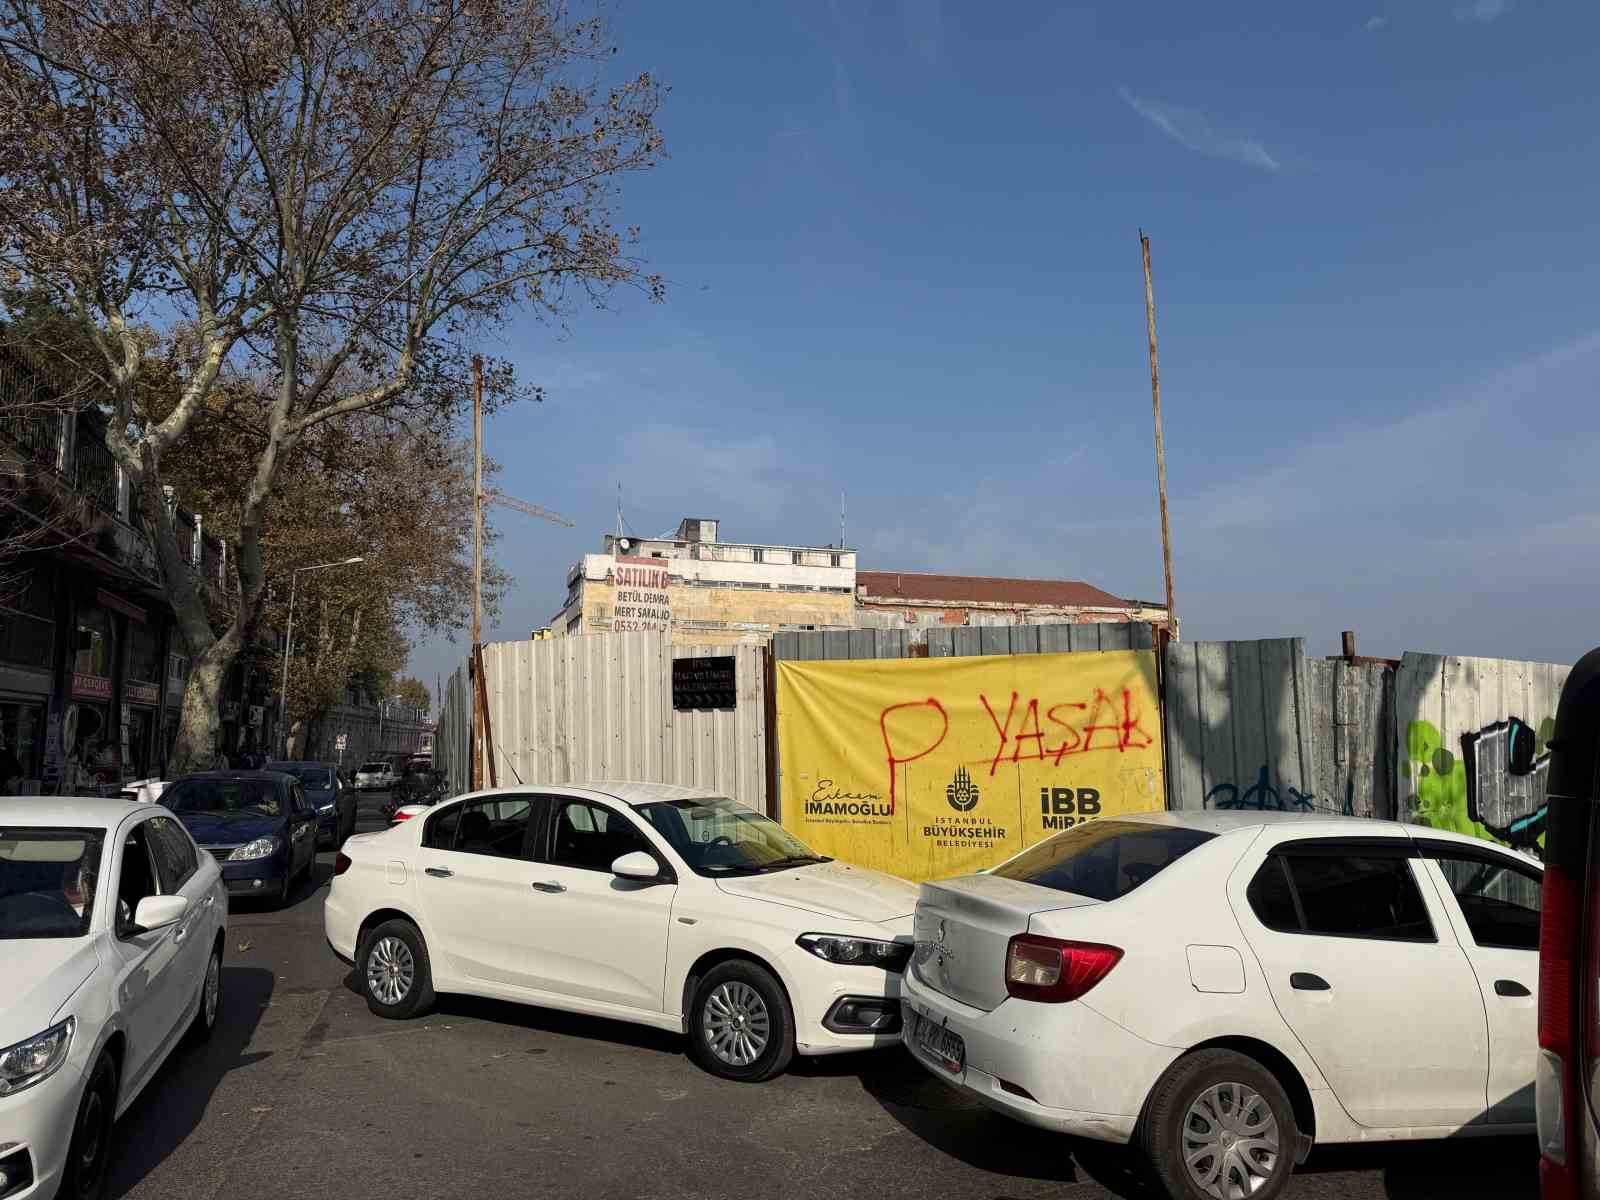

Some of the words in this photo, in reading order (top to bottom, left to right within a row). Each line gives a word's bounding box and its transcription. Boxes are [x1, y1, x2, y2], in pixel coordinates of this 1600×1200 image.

[616, 567, 659, 588] SATILIK
[617, 590, 642, 603] BETÜL
[614, 606, 636, 618] MERT
[880, 698, 948, 816] P
[805, 800, 891, 817] İMAMOĞLU
[935, 815, 993, 825] İSTANBUL
[923, 824, 1006, 839] BÜYÜKŞEHİR
